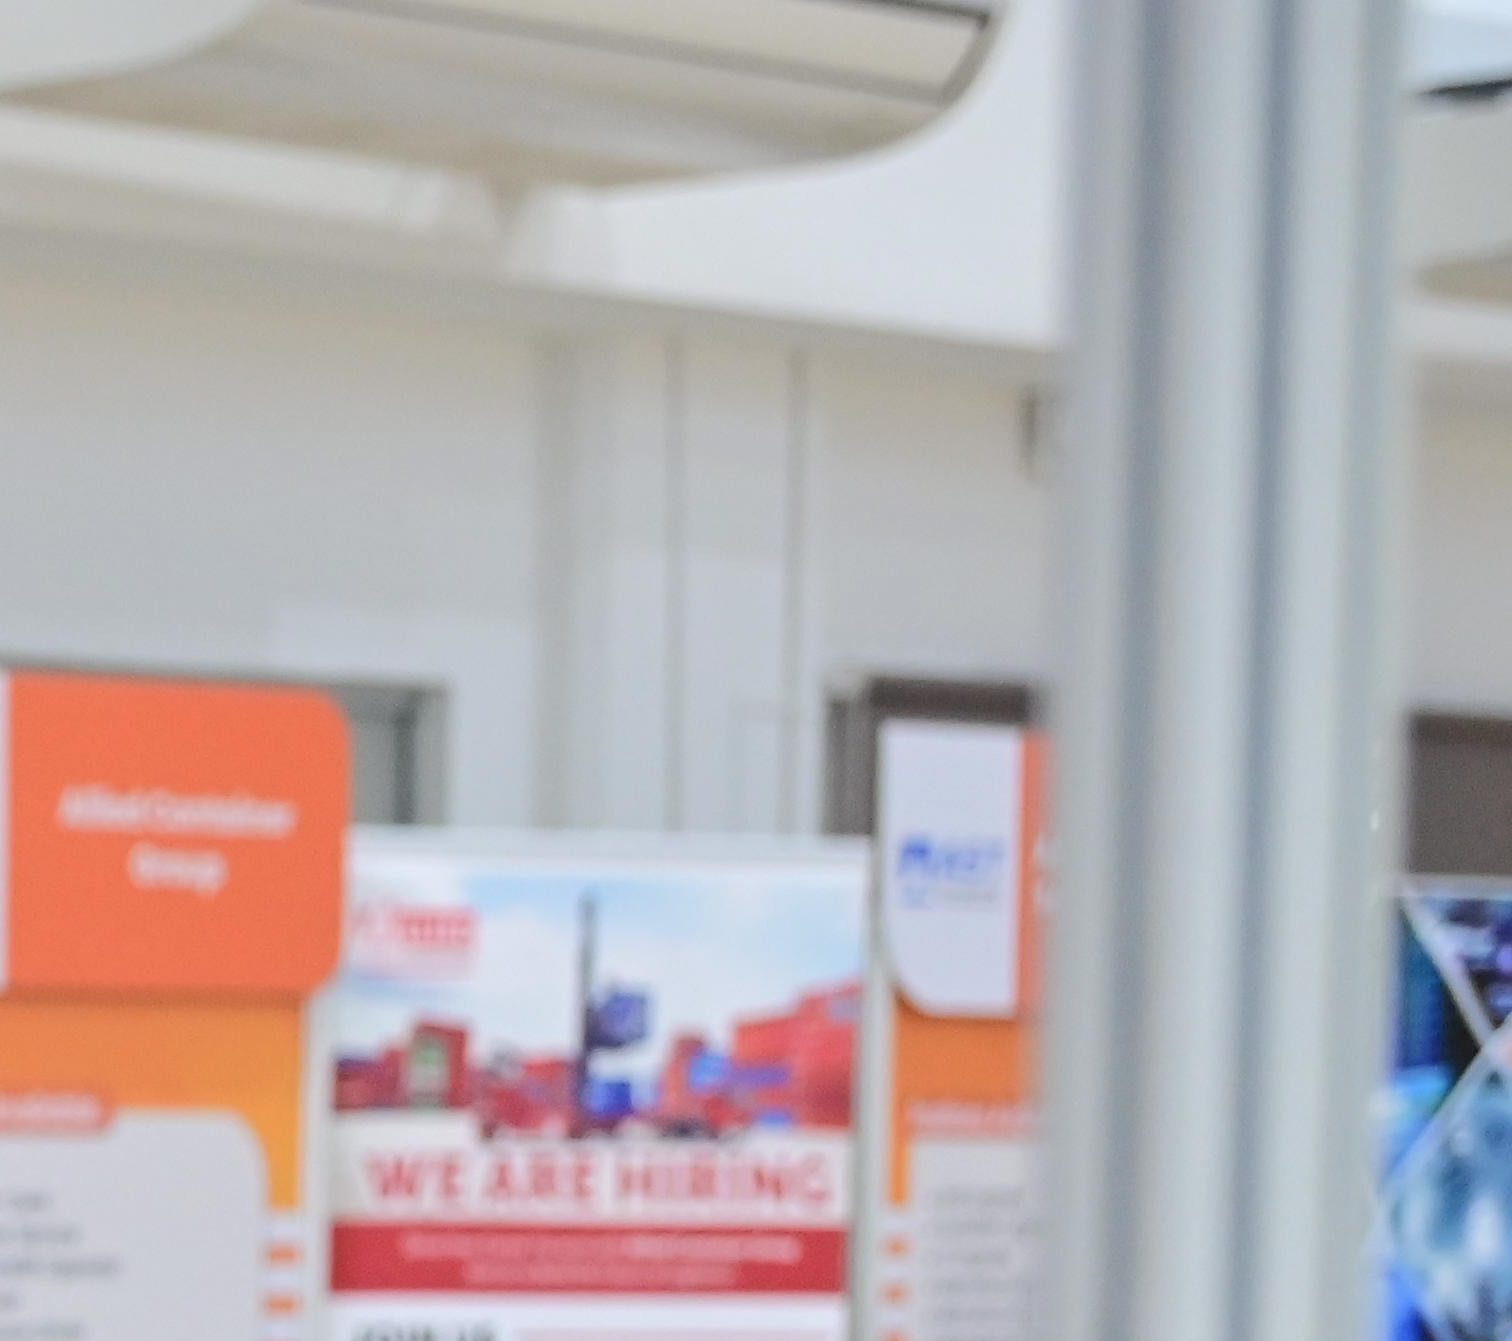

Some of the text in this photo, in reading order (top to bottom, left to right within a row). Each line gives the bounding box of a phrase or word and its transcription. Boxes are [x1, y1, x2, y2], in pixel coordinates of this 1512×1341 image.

[367, 1148, 830, 1211] WE ARE HIRING
